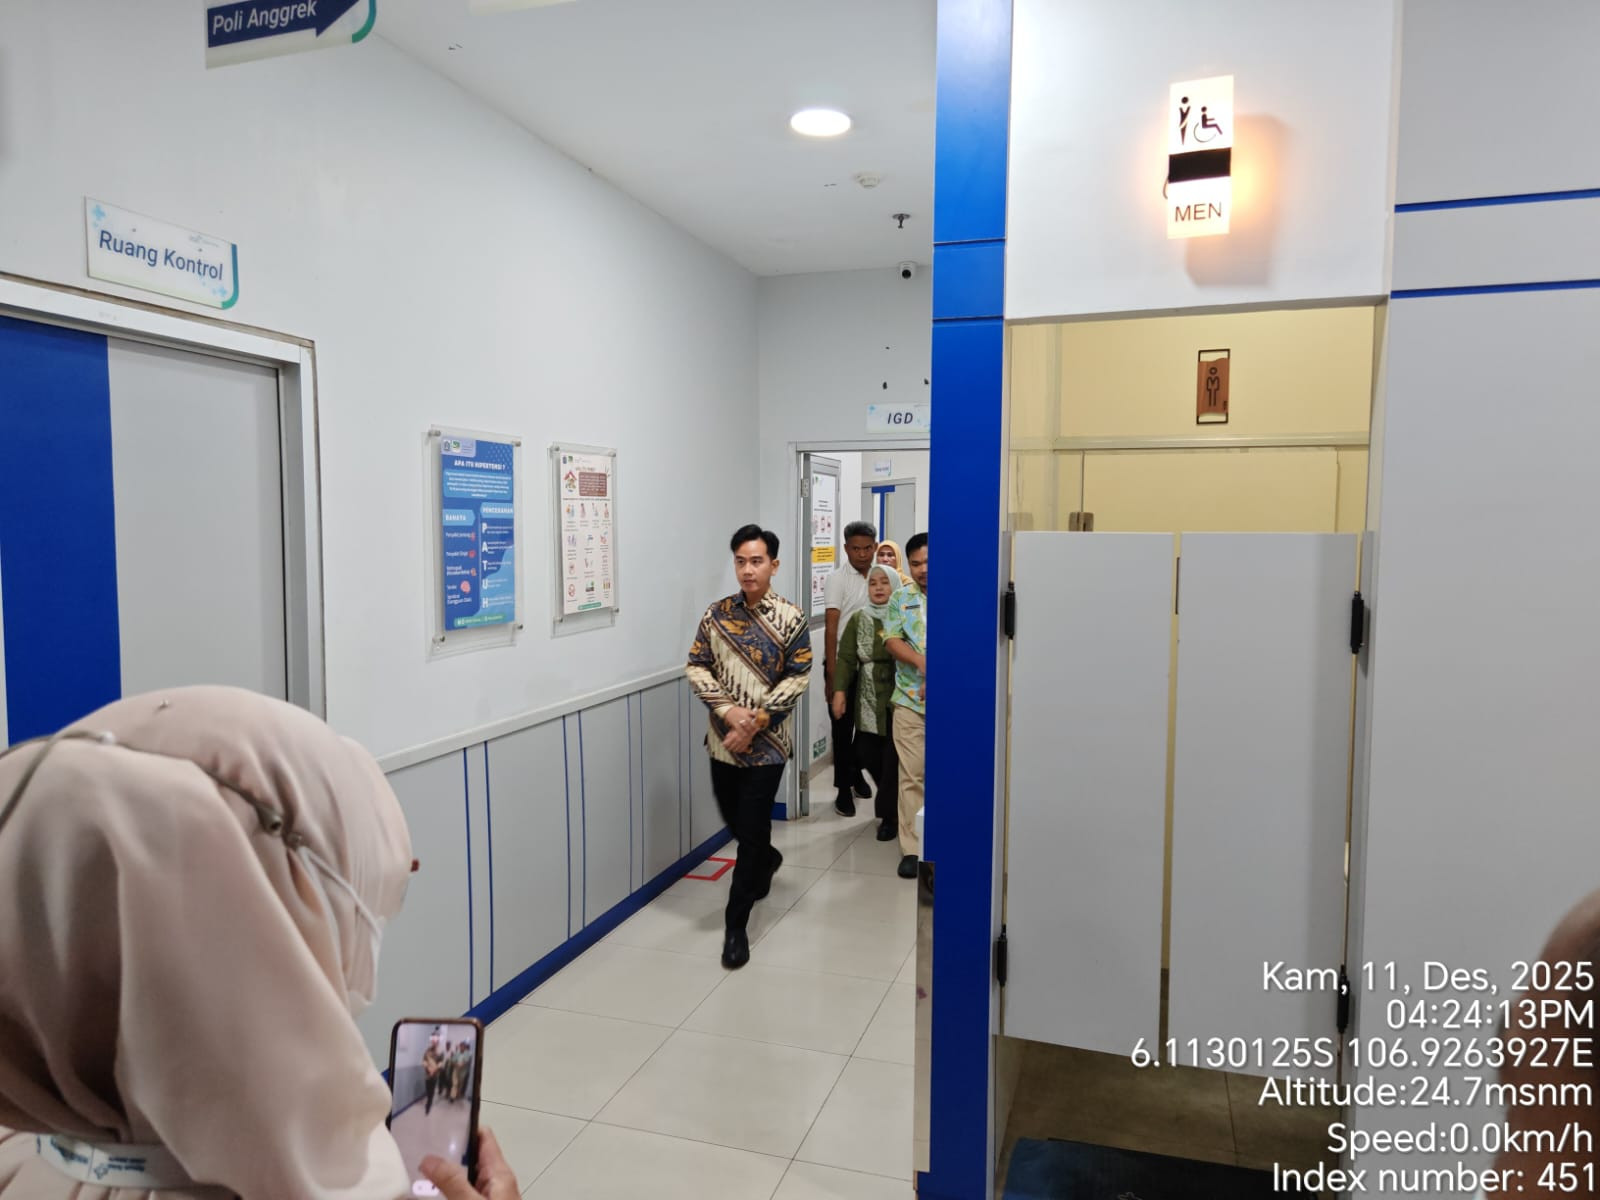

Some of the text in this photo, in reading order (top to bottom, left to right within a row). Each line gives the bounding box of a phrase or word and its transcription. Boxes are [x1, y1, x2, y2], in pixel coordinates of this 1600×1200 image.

[212, 0, 317, 35] Poli Anggrek
[1175, 202, 1222, 222] MEN
[99, 230, 158, 267] Ruang
[163, 248, 224, 281] Kontrol
[887, 412, 914, 425] IGD
[481, 522, 488, 534] P
[481, 541, 488, 552] A
[482, 560, 488, 571] T
[482, 579, 488, 590] U
